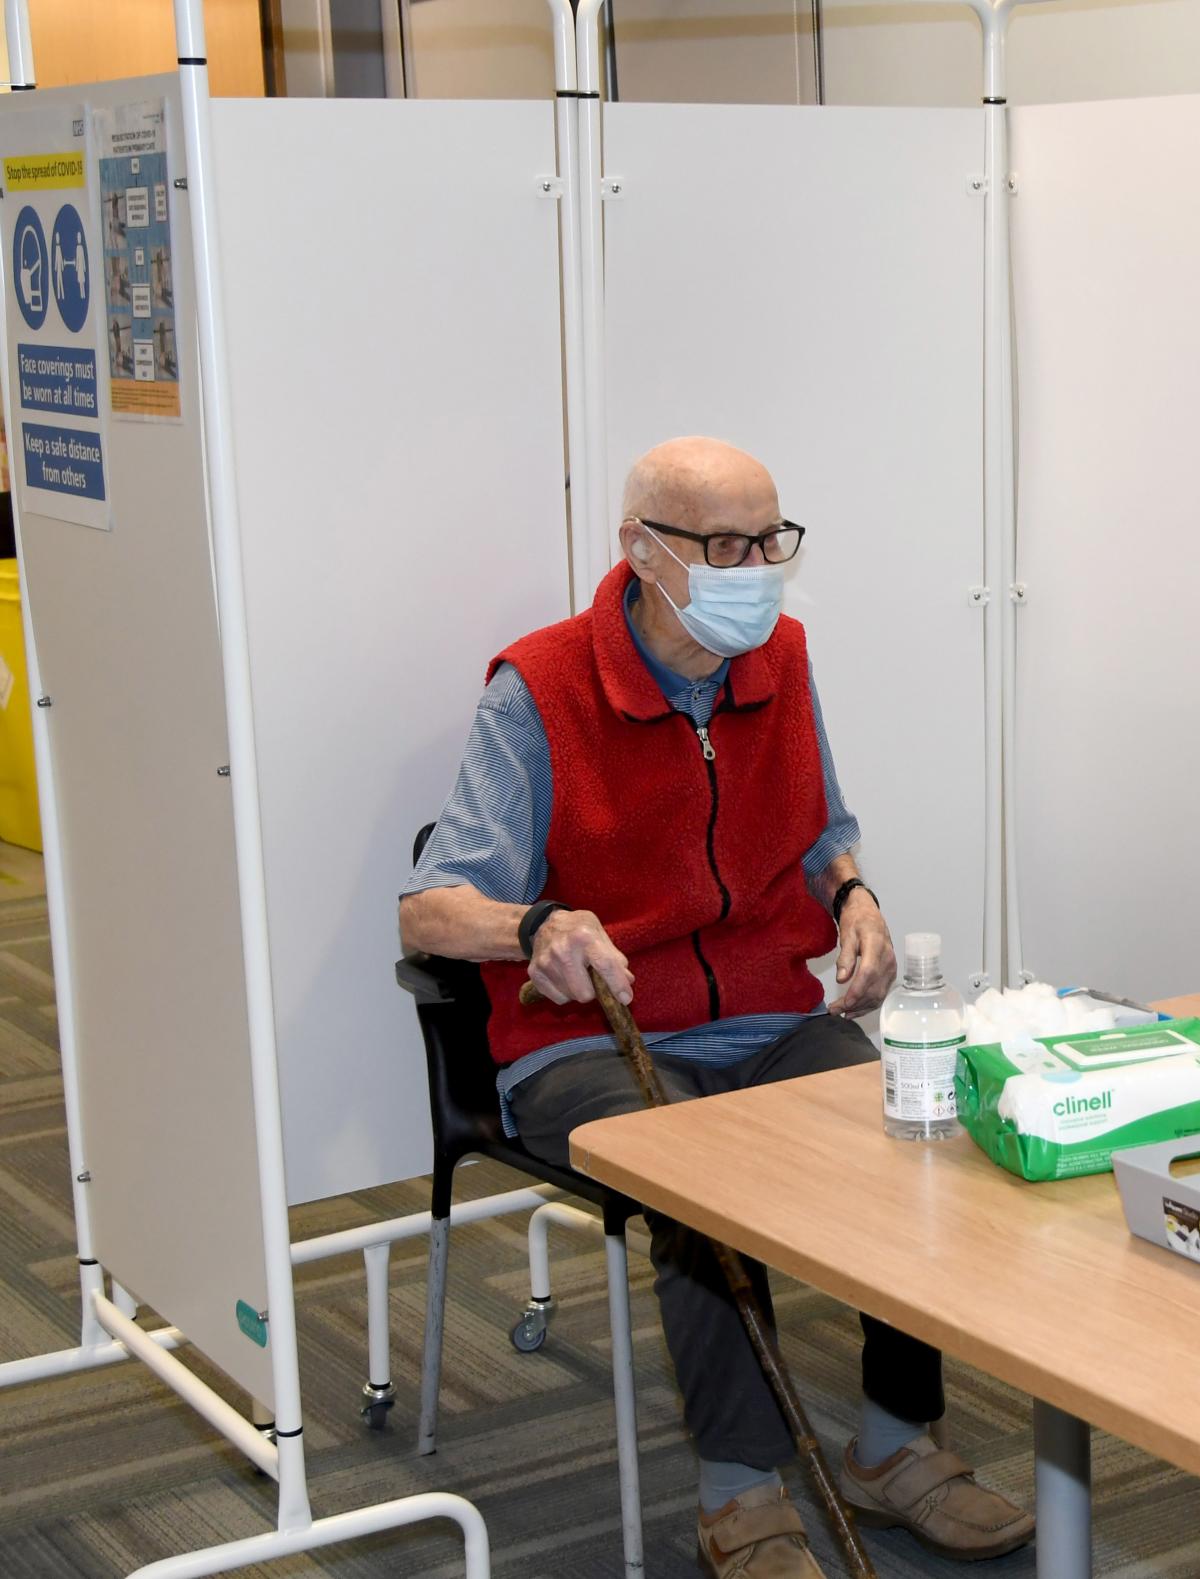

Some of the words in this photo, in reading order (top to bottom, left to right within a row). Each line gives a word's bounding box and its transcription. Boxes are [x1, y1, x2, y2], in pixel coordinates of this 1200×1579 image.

[6, 165, 21, 182] Stop
[21, 163, 31, 179] the
[31, 161, 50, 182] spread
[50, 160, 57, 176] of
[57, 160, 83, 176] COVID-19
[20, 353, 36, 374] Face
[37, 355, 73, 382] coverings
[75, 361, 94, 380] must
[22, 379, 32, 401] be
[33, 385, 52, 403] worn
[53, 386, 62, 404] at
[63, 384, 73, 405] all
[74, 386, 94, 408] times
[24, 432, 44, 458] Keep
[45, 440, 50, 455] a
[51, 435, 67, 457] safe
[68, 437, 100, 463] distance
[42, 460, 60, 484] from
[61, 465, 86, 489] others
[1053, 1090, 1112, 1116] clinell
